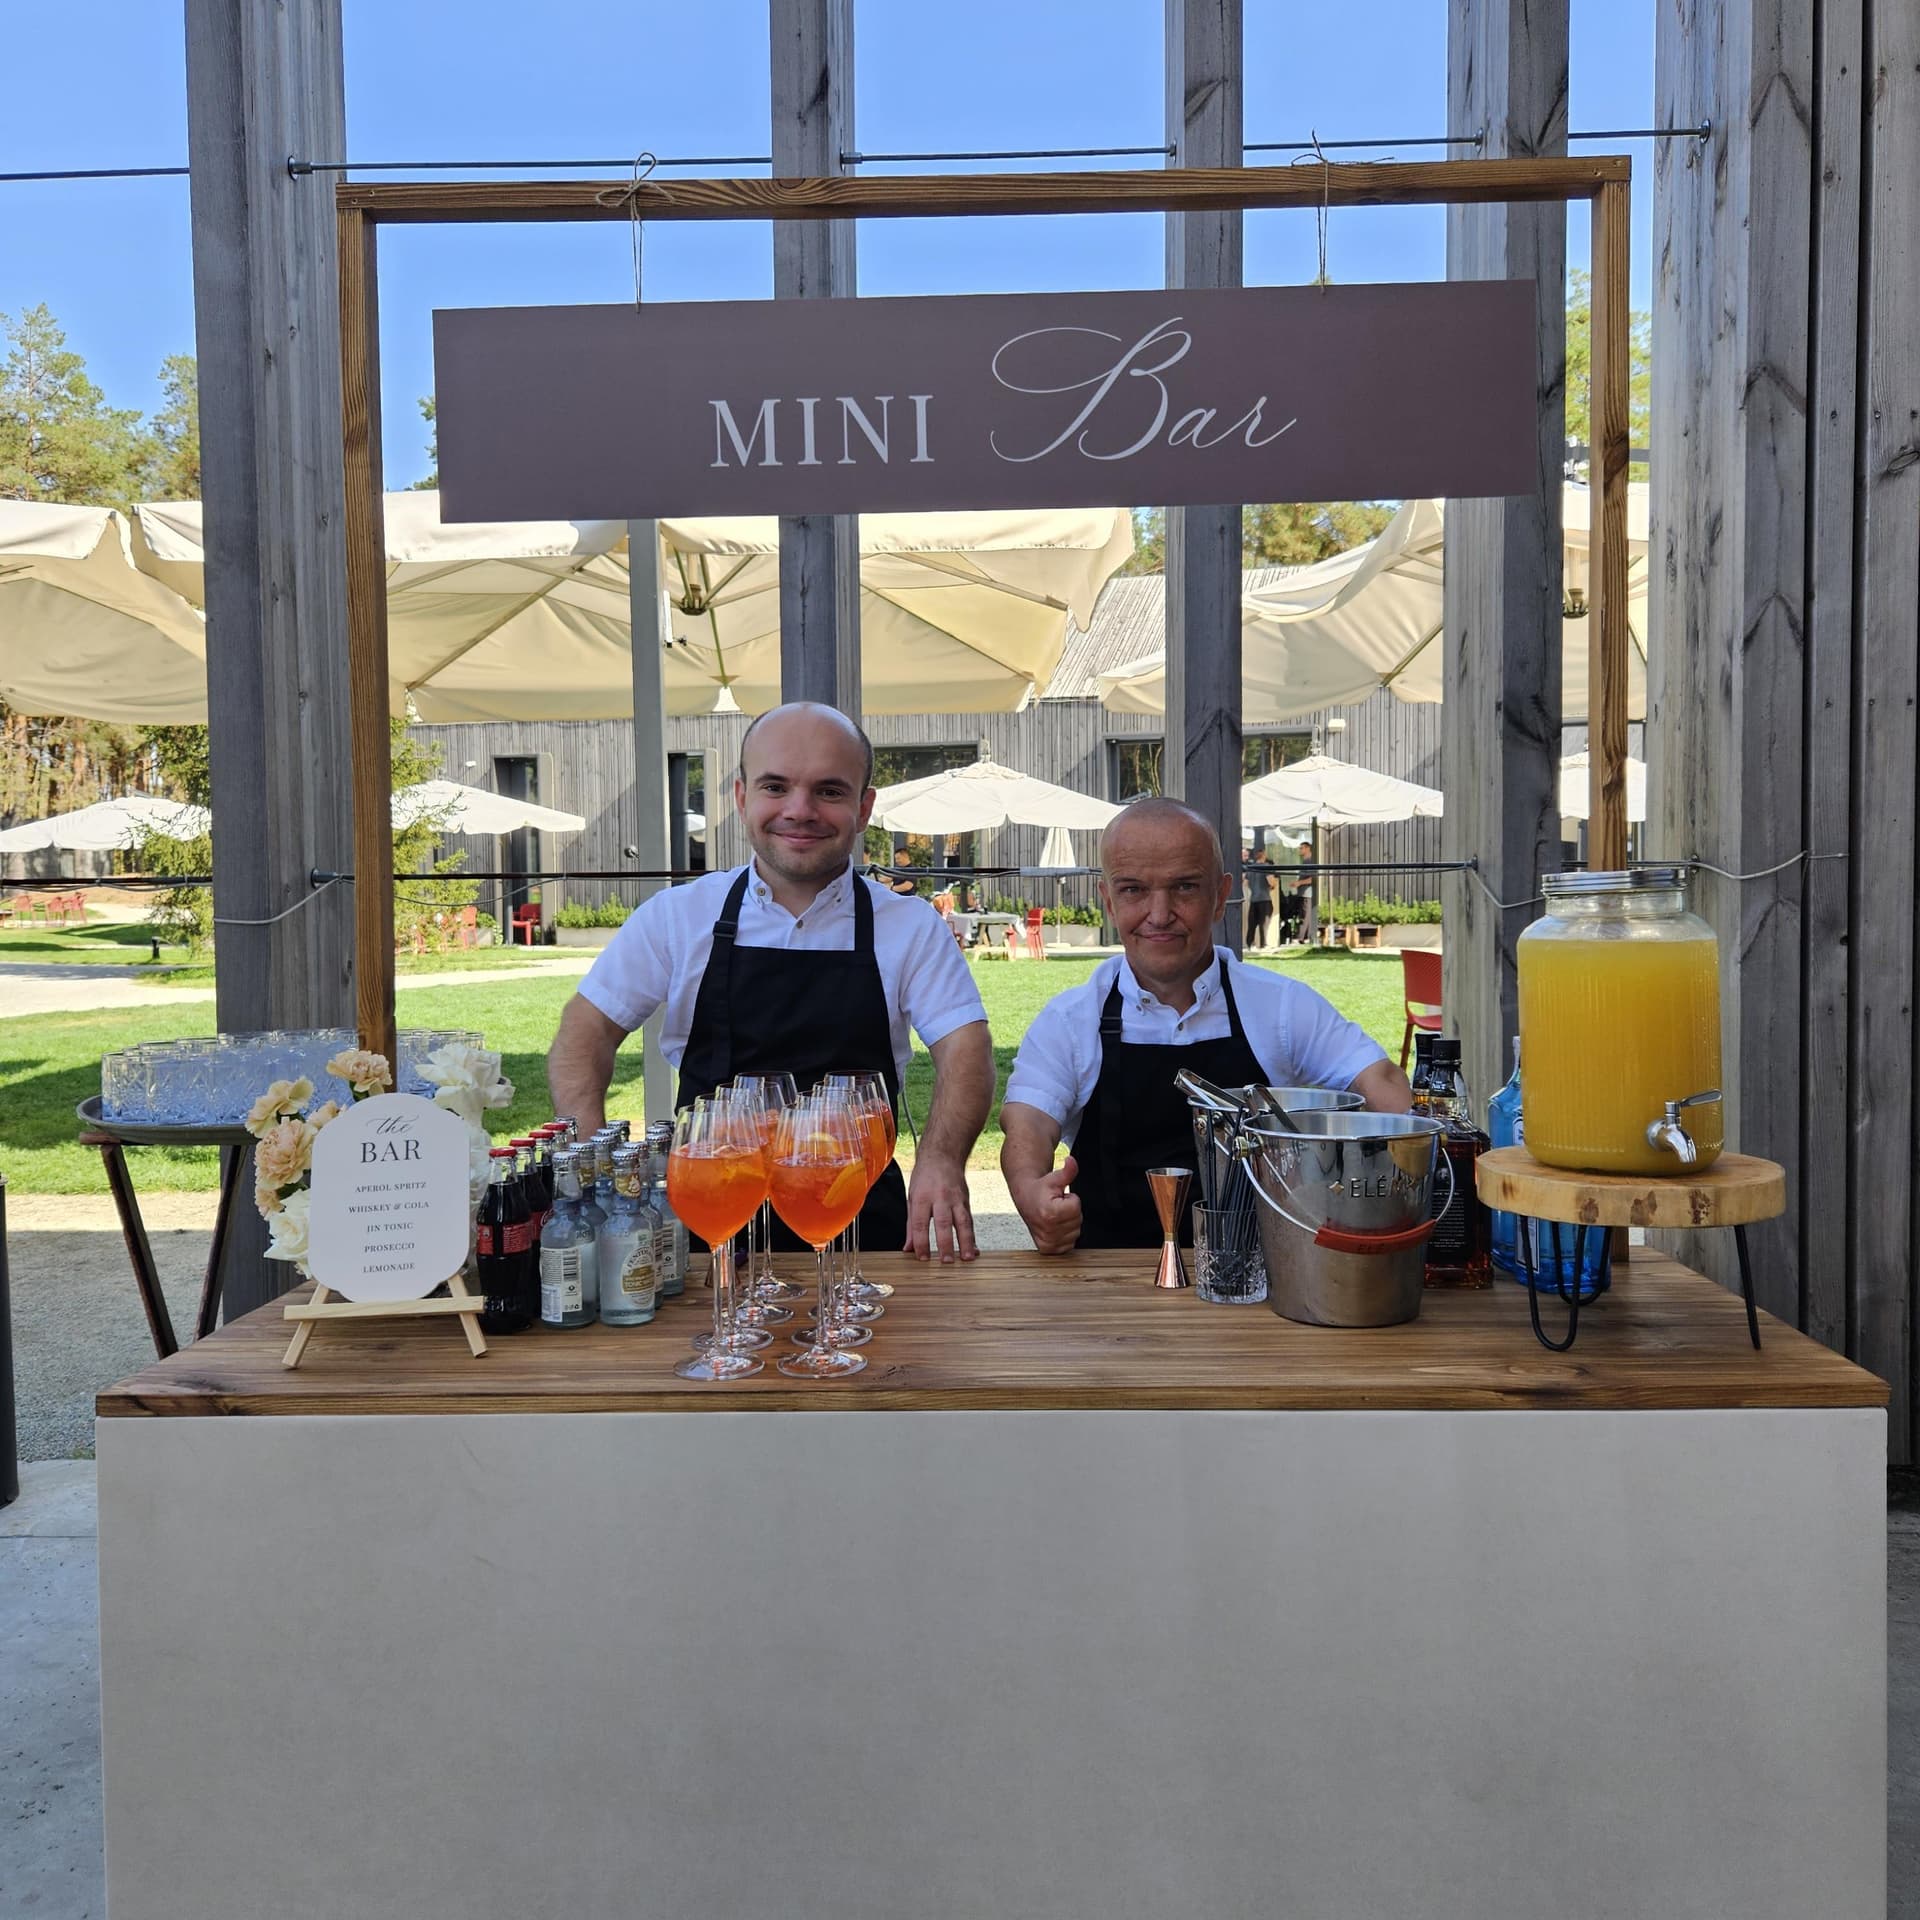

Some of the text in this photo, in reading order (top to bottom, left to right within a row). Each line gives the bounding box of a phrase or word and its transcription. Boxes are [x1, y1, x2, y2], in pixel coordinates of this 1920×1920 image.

[708, 316, 1298, 469] MINI Bar
[366, 1115, 420, 1135] the
[360, 1139, 422, 1163] BAR
[355, 1181, 427, 1193] APEROL SPRITZ
[348, 1201, 430, 1213] WHISKEY & COLA
[366, 1221, 414, 1233] JIN TONIC
[364, 1242, 415, 1253] PROSECCO
[363, 1262, 416, 1273] LEMONADE
